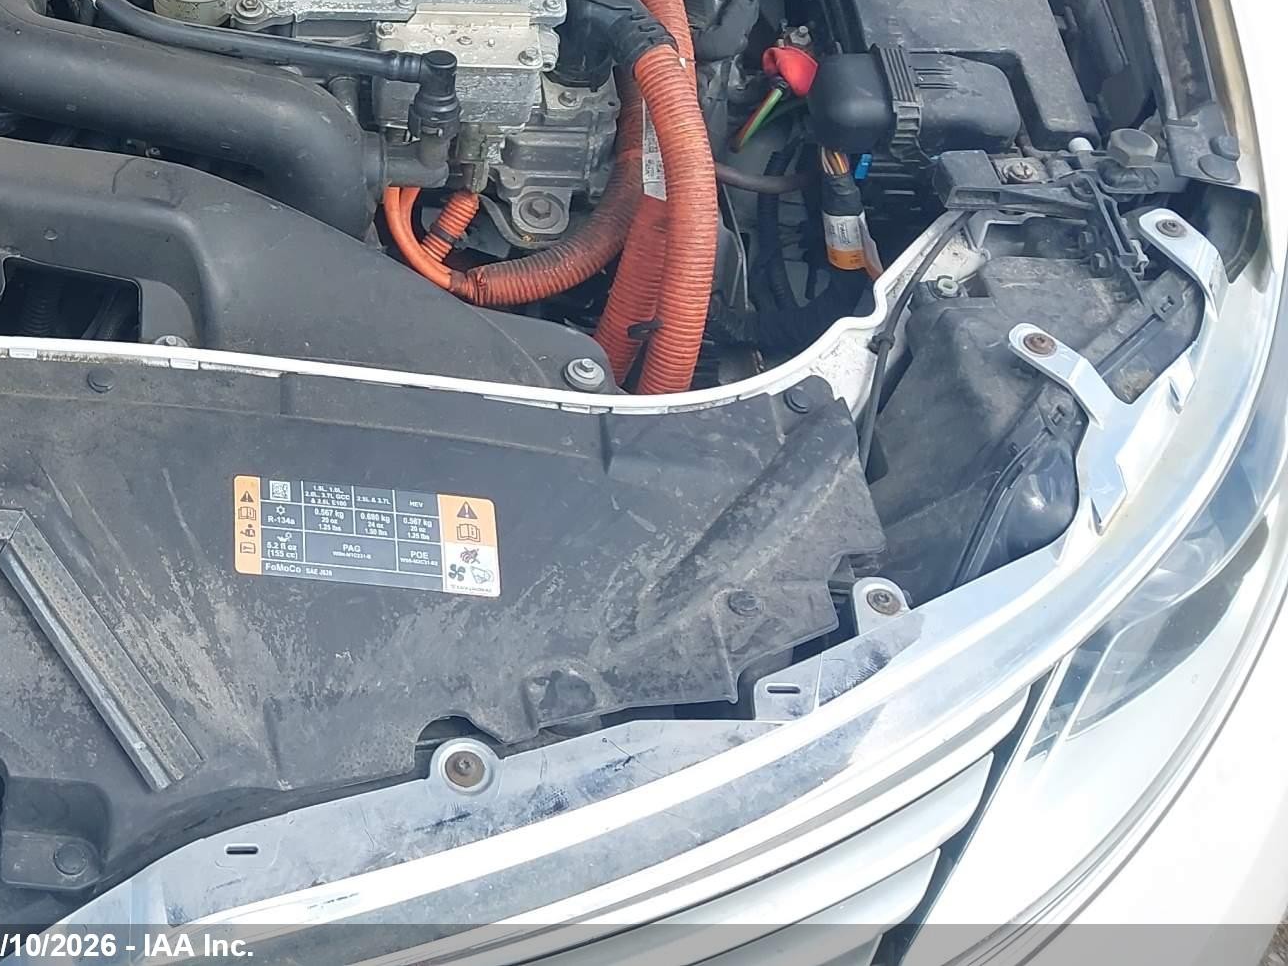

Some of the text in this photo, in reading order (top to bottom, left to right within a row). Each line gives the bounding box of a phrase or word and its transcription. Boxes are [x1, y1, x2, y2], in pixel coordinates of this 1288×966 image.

[409, 500, 424, 508] HEV
[334, 510, 344, 520] kg
[380, 514, 391, 524] kg
[267, 515, 296, 526] R-134a
[423, 518, 432, 528] kg
[266, 541, 280, 550] 5.2
[280, 542, 286, 550] fl
[342, 544, 361, 553] PAG
[267, 549, 298, 560] (155 cc)
[410, 550, 430, 560] POE
[265, 562, 302, 574] FoMoCo
